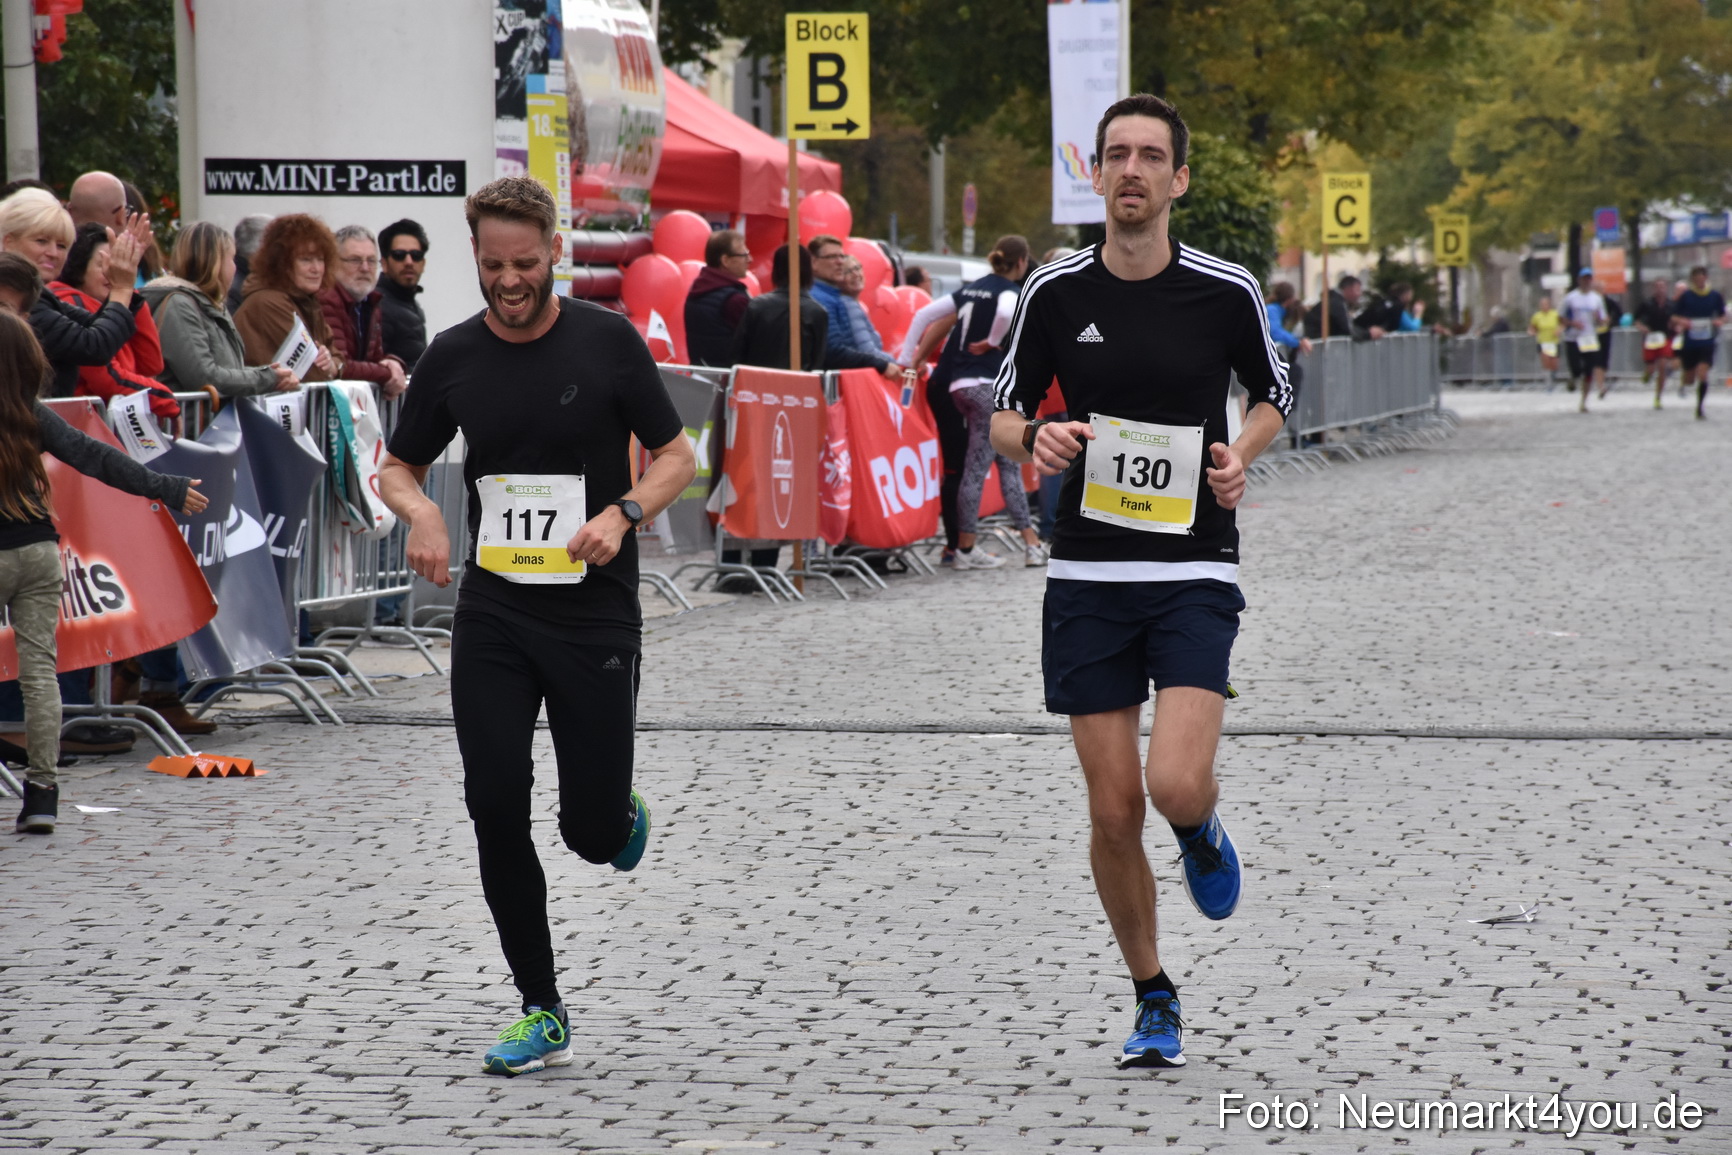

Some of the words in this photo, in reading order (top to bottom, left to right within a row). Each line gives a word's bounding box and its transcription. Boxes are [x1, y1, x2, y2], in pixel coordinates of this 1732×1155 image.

[797, 19, 858, 41] Block
[809, 52, 848, 111] B
[531, 114, 555, 137] 18.
[206, 163, 456, 192] www.MINI-Partl.de
[1328, 178, 1363, 189] Block
[1335, 195, 1356, 227] C
[1443, 230, 1459, 254] D
[126, 404, 145, 438] swn
[1131, 431, 1171, 446] BOCK
[1112, 452, 1172, 490] 130
[514, 485, 551, 495] BOCK
[1120, 496, 1152, 512] Frank
[502, 508, 558, 541] 117
[511, 553, 545, 565] Jonas
